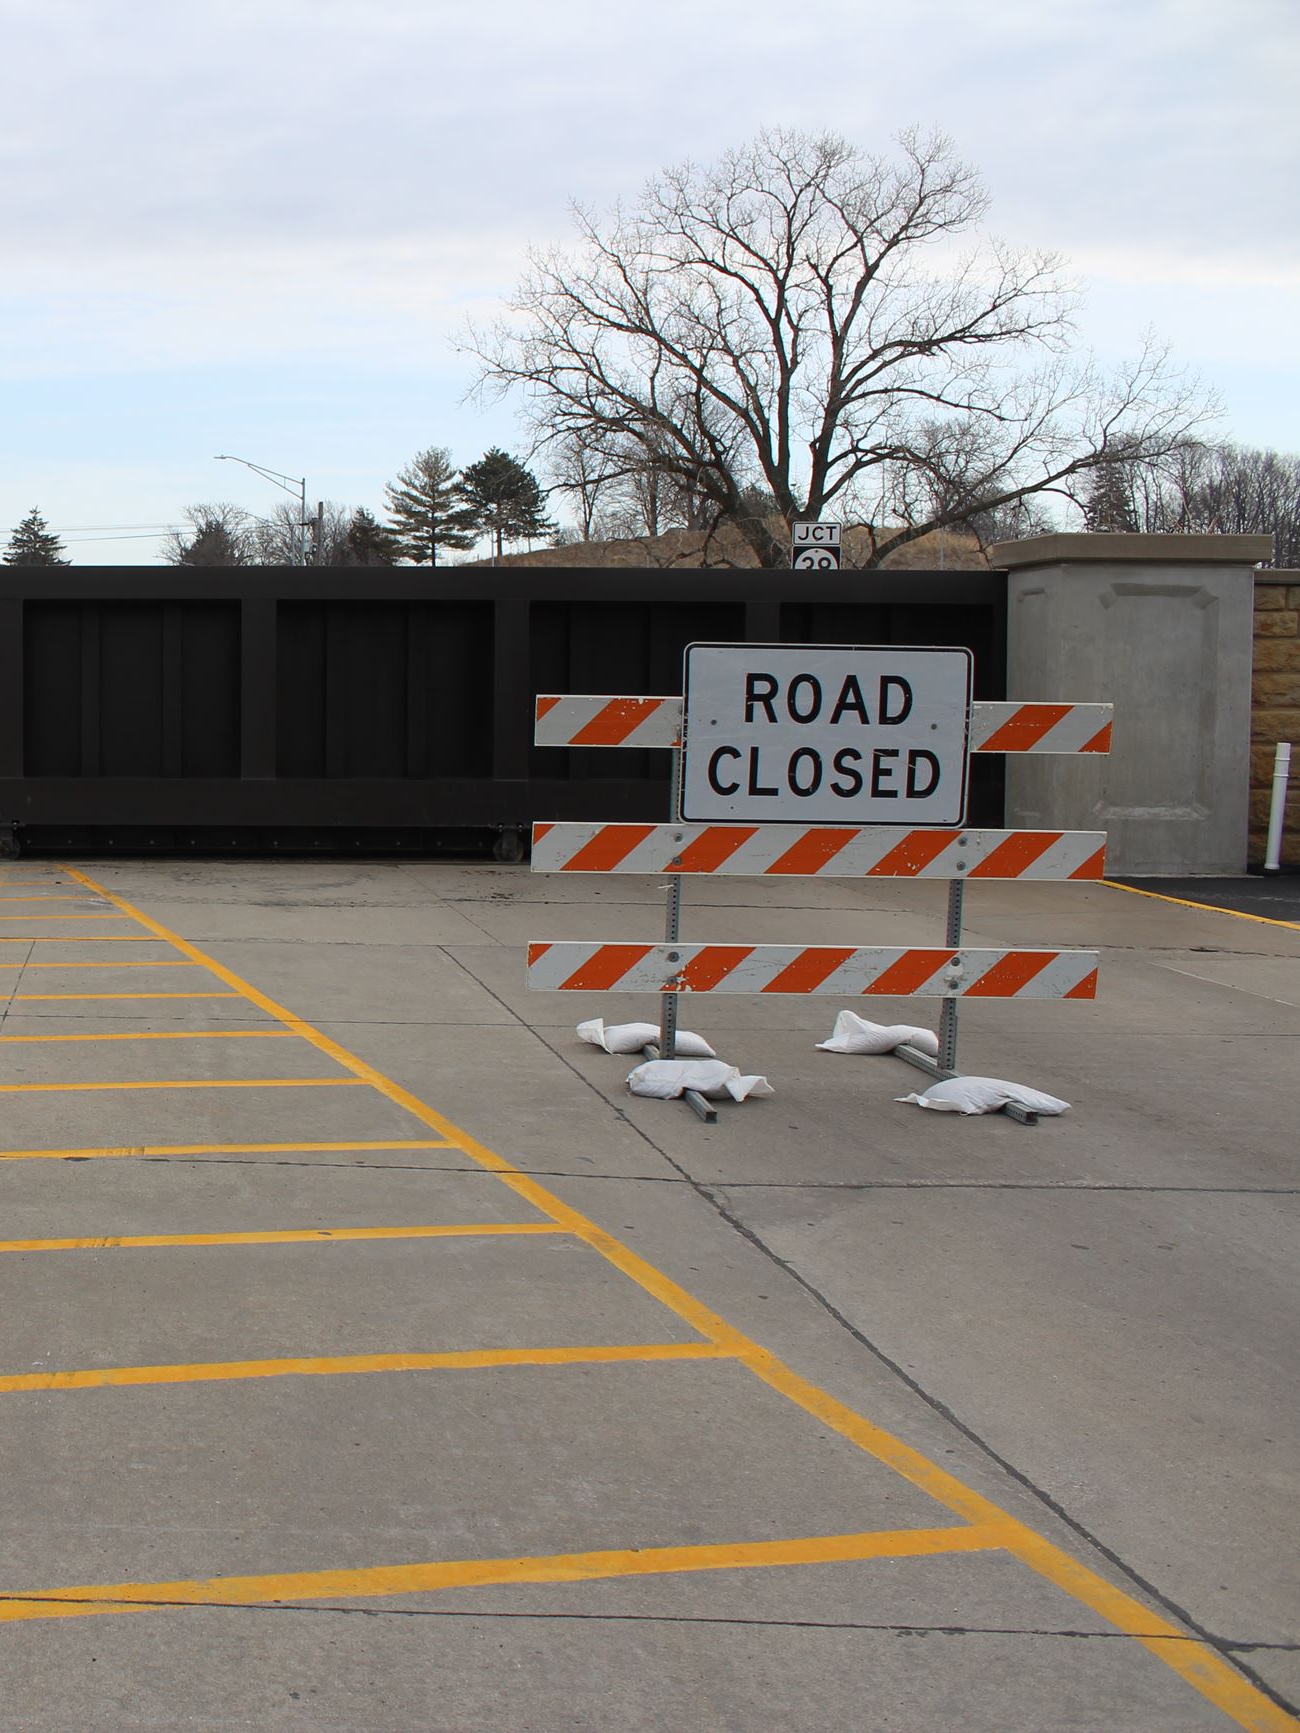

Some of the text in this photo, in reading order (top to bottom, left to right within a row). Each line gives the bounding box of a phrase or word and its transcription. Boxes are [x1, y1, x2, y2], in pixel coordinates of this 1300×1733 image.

[797, 526, 837, 541] JCT
[744, 672, 913, 725] ROAD
[707, 745, 941, 799] CLOSED
